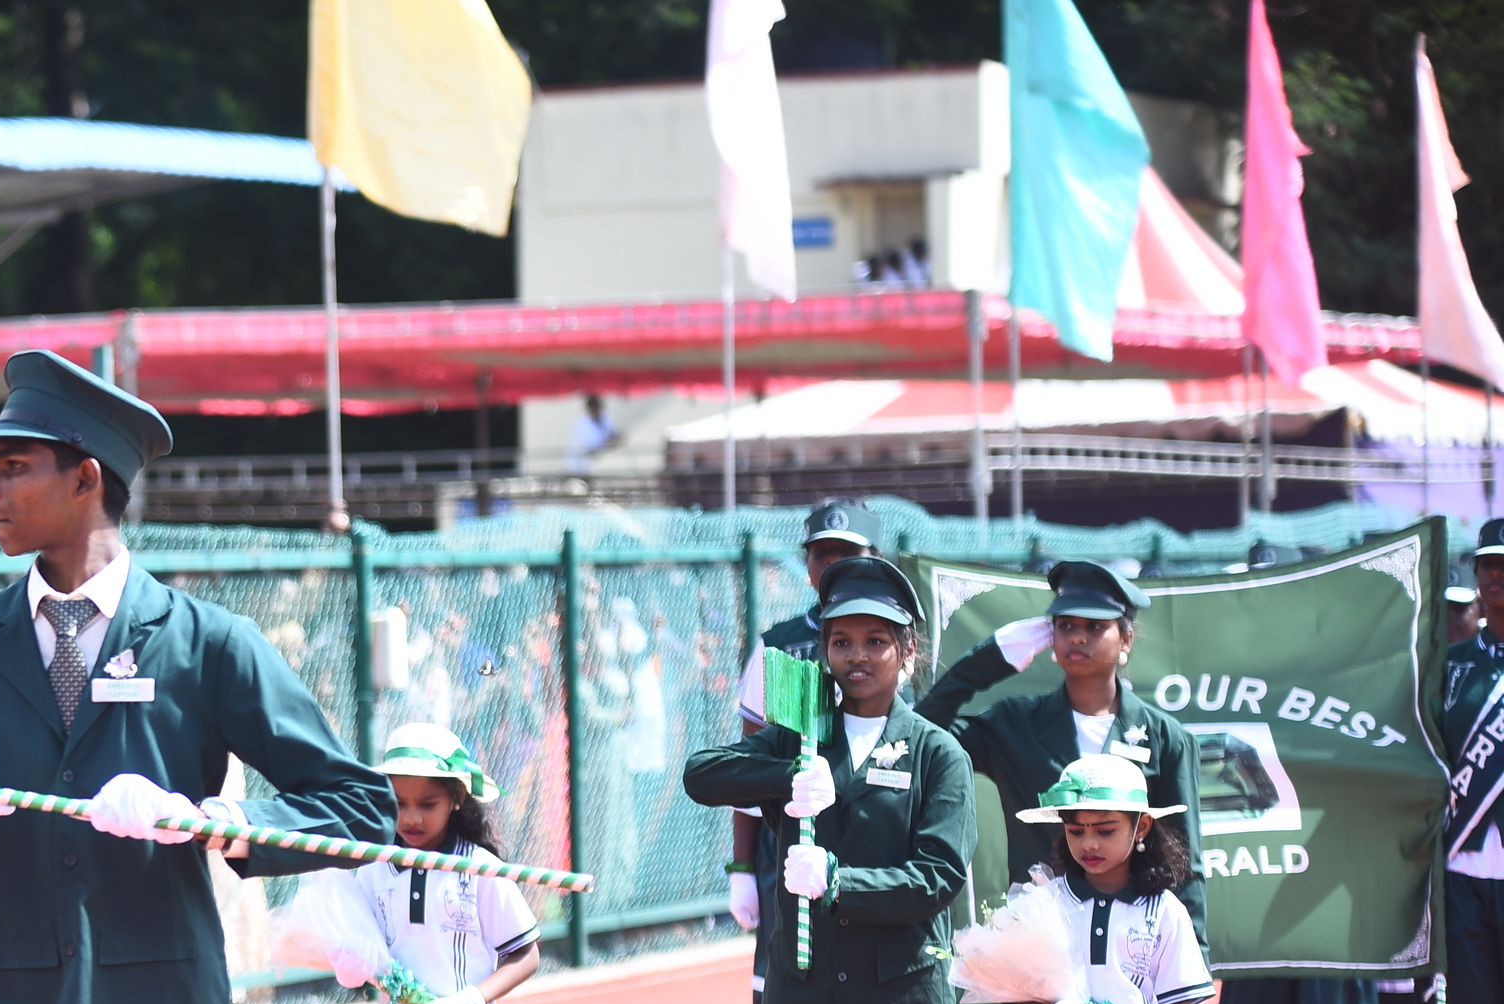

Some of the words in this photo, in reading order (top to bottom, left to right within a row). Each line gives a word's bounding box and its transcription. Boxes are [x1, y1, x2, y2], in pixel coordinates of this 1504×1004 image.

[1155, 673, 1268, 714] OUR
[1278, 686, 1407, 747] BEST
[1202, 844, 1309, 878] RALD
